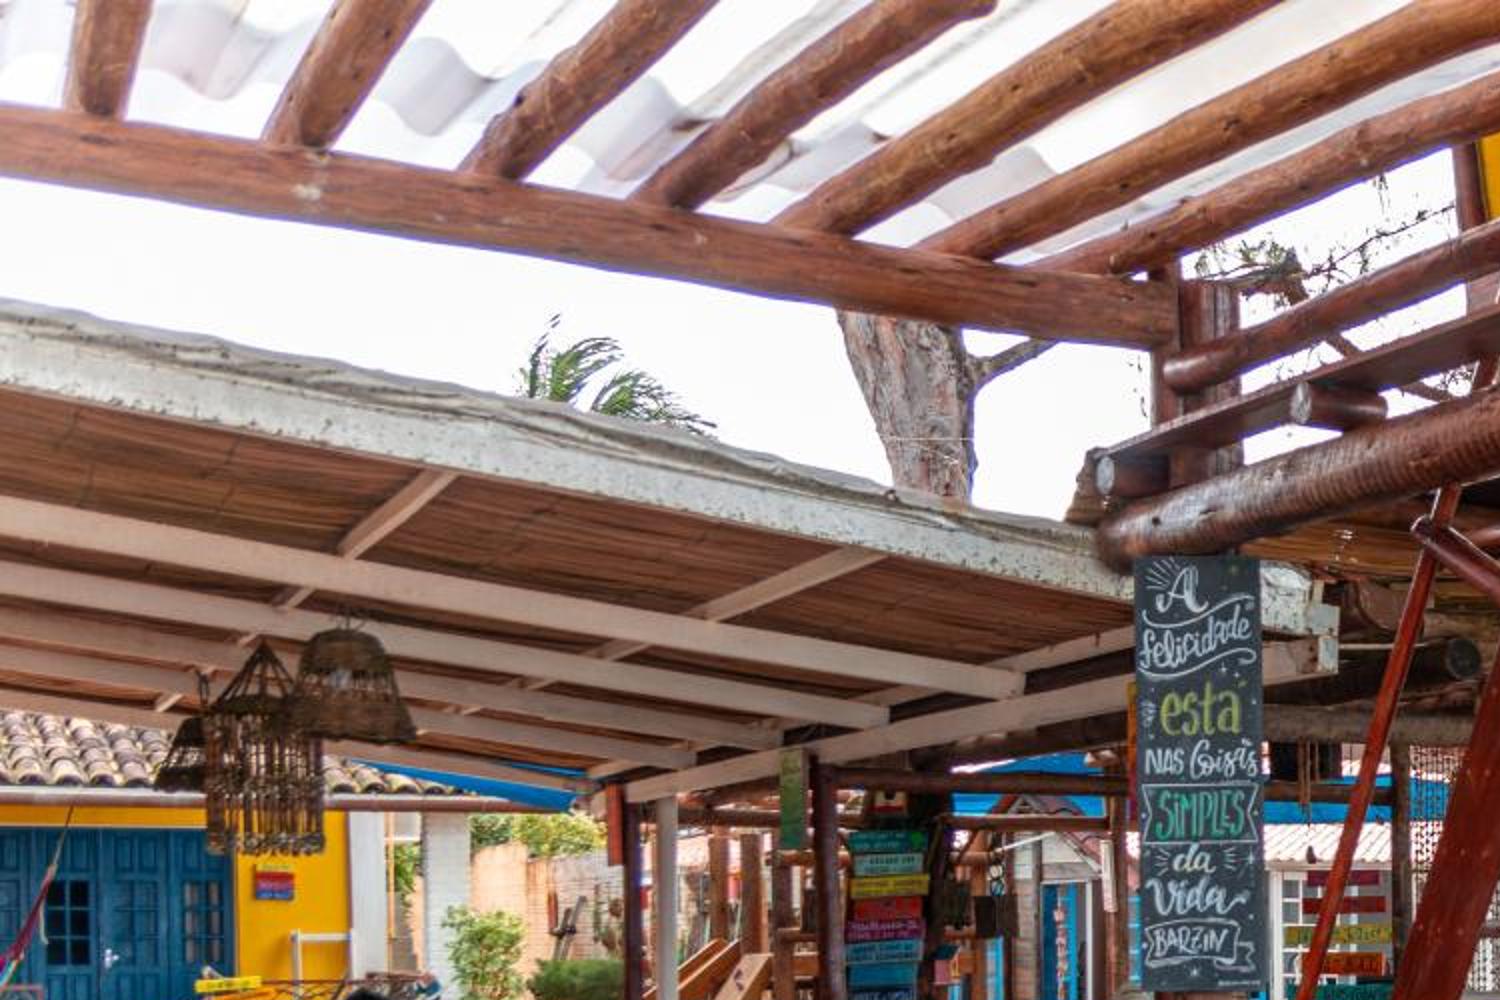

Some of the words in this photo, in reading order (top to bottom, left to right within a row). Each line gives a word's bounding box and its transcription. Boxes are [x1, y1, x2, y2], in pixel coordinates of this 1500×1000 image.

[1155, 565, 1209, 613] A
[1139, 604, 1252, 669] felicidade
[1145, 747, 1185, 775] NAS
[1172, 843, 1216, 874] da
[1152, 925, 1229, 957] BARZIN
